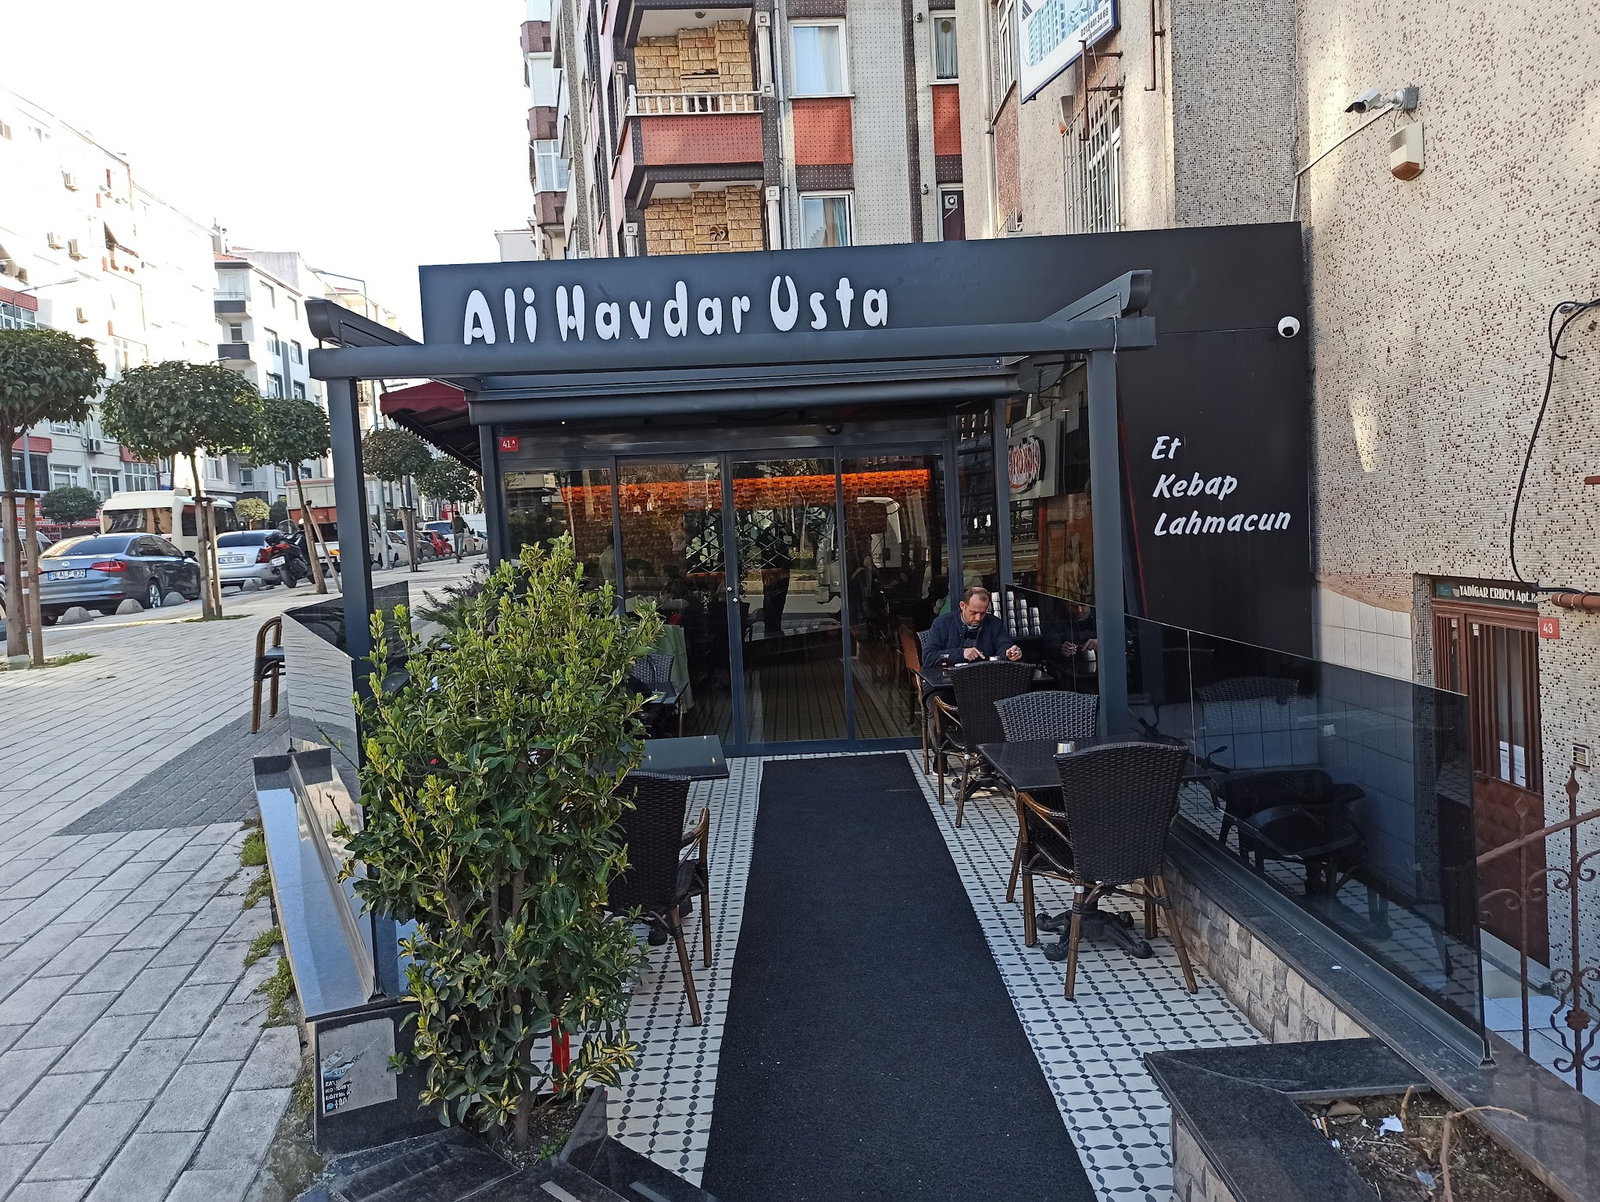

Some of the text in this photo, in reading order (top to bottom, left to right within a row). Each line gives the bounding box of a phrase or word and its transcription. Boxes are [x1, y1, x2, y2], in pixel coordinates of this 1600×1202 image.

[463, 286, 537, 345] Ali
[770, 275, 888, 332] Usta
[1151, 435, 1182, 460] Et
[1152, 471, 1239, 501] Kebap
[1153, 509, 1292, 537] Lahmacun
[1459, 584, 1489, 598] YADİGAR
[1490, 587, 1516, 600] ERDEM
[1543, 622, 1553, 634] 43
